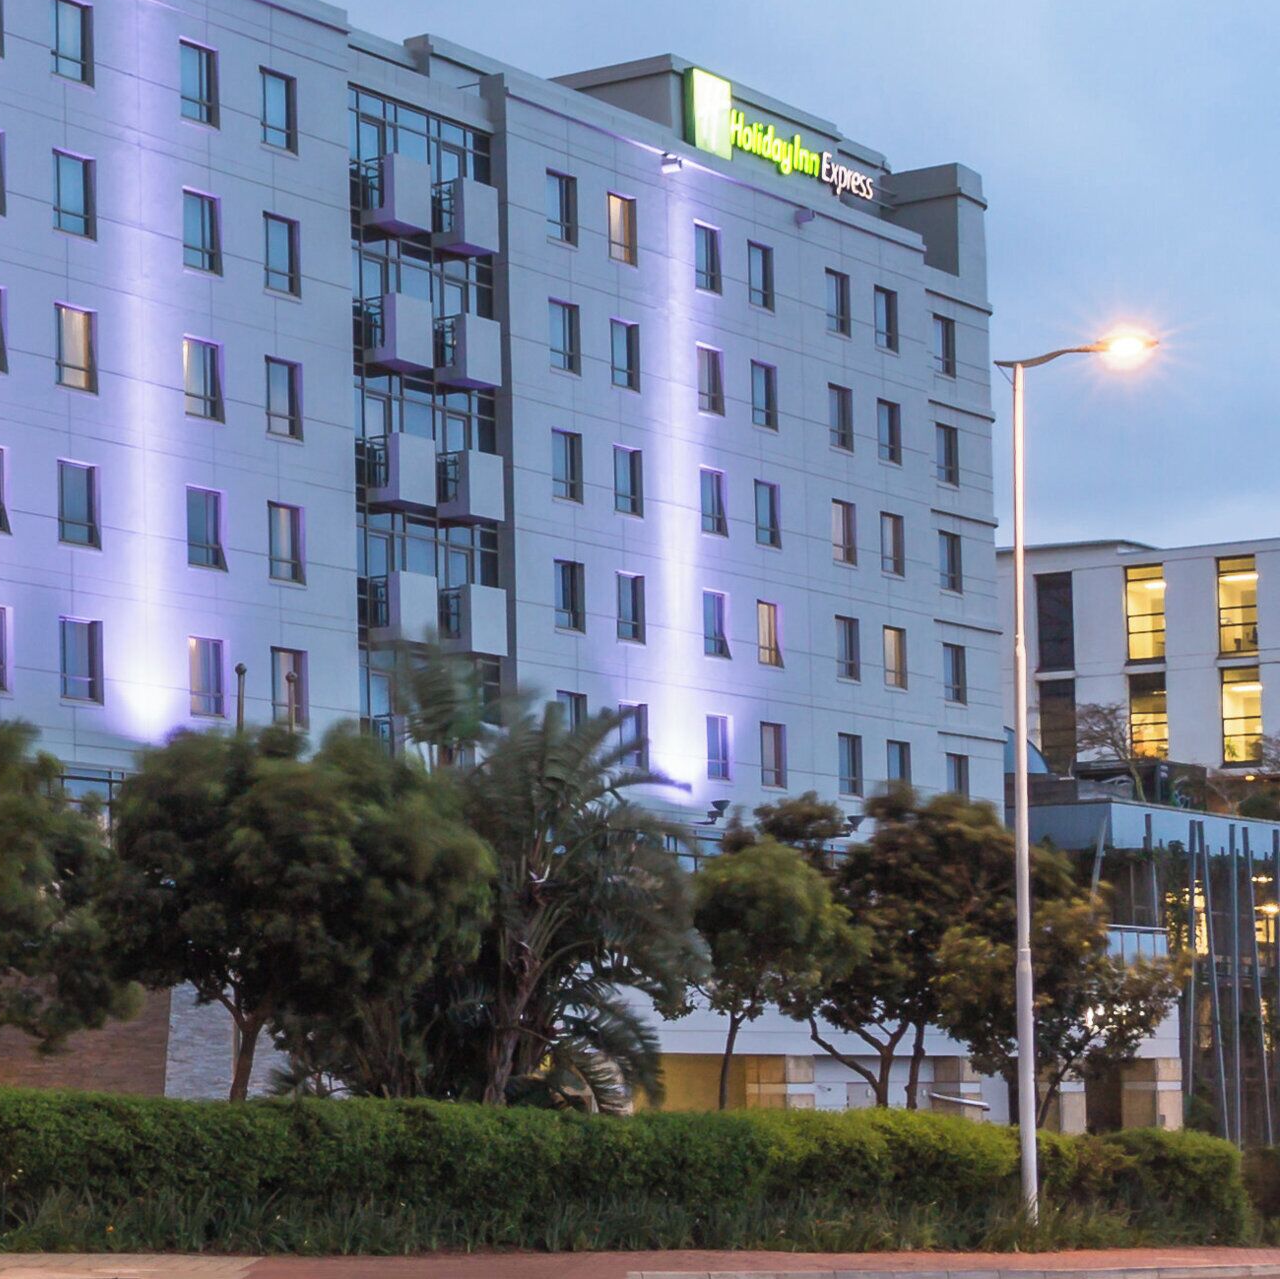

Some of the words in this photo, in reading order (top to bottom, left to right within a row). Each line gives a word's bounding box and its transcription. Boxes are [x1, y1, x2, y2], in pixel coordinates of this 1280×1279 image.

[730, 109, 793, 175] Holiday
[794, 134, 819, 177] Inn
[822, 152, 873, 200] Express
